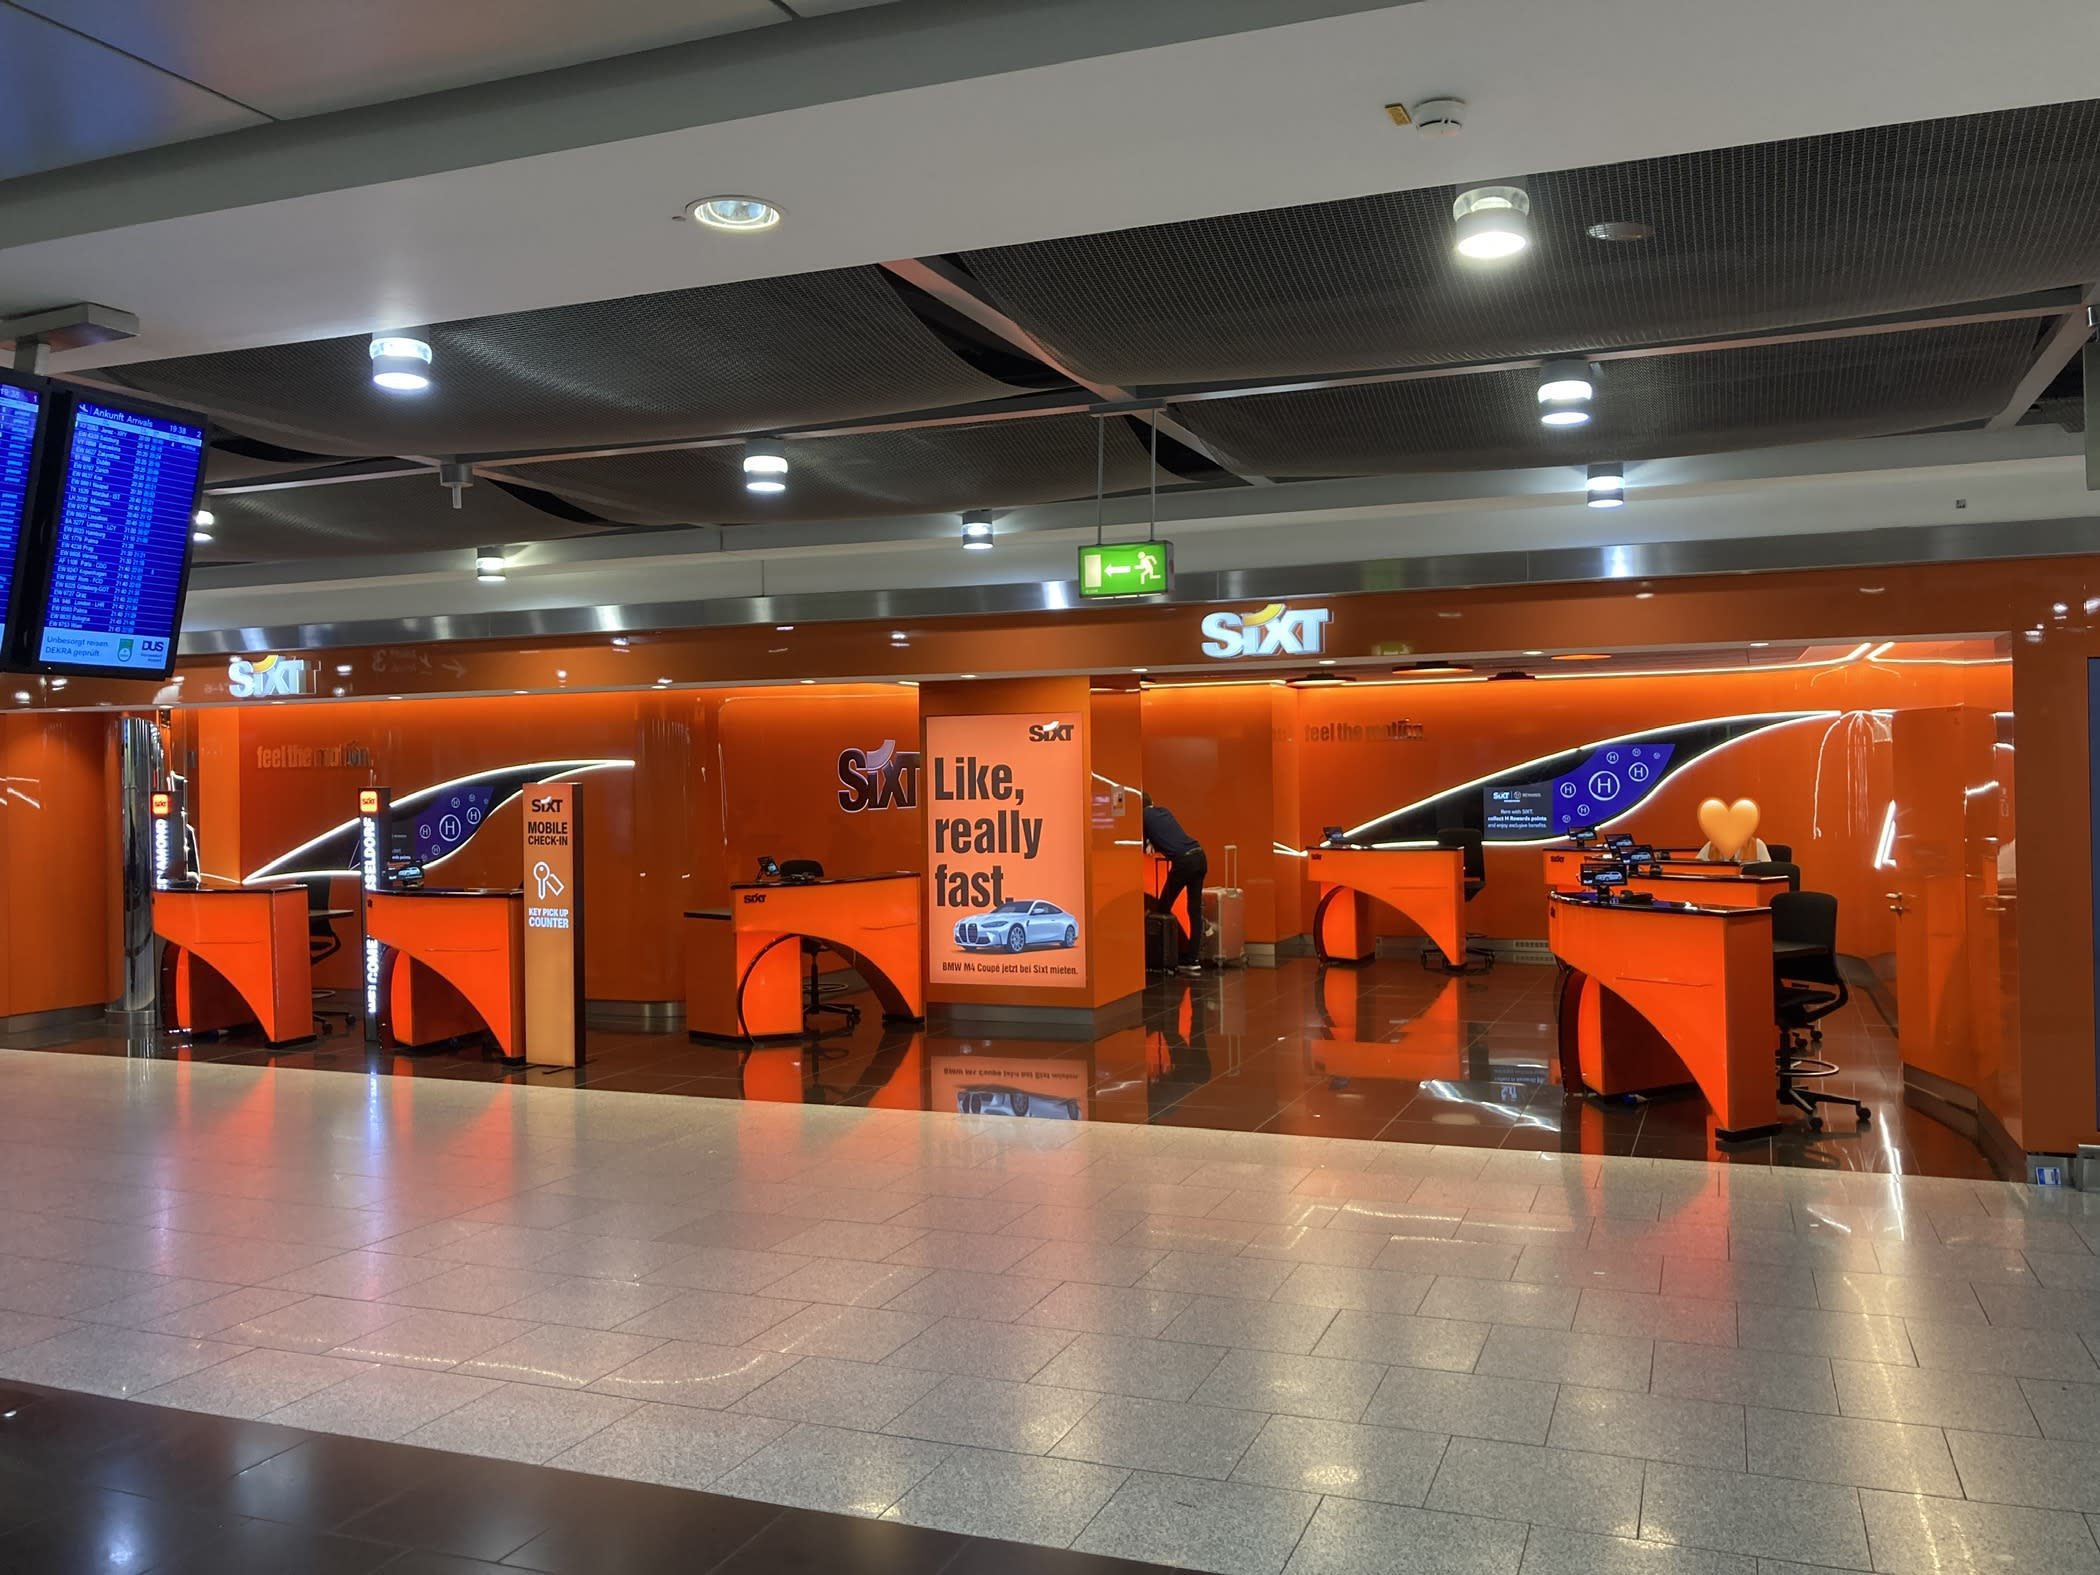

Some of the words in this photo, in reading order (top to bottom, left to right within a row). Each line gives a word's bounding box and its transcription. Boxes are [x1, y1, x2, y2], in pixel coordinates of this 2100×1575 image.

[93, 408, 125, 421] Ankunft
[127, 416, 153, 428] Arrivals
[46, 636, 86, 647] Unbesorgt
[142, 640, 164, 652] DUS
[45, 646, 72, 655] DEKRA
[257, 745, 287, 769] feel
[934, 757, 1024, 806] Like,
[528, 821, 568, 835] MOBILE
[528, 836, 568, 846] CHECK-IN
[935, 810, 1043, 860] really
[528, 907, 542, 917] KEY
[542, 908, 559, 917] PICK
[559, 908, 569, 918] UP
[528, 916, 569, 929] COUNTER
[942, 961, 961, 971] BMW
[963, 961, 975, 971] M4
[977, 962, 1000, 973] Coupé
[1001, 963, 1018, 974] jetzt
[1019, 963, 1032, 973] bei
[1033, 964, 1049, 974] Sixt
